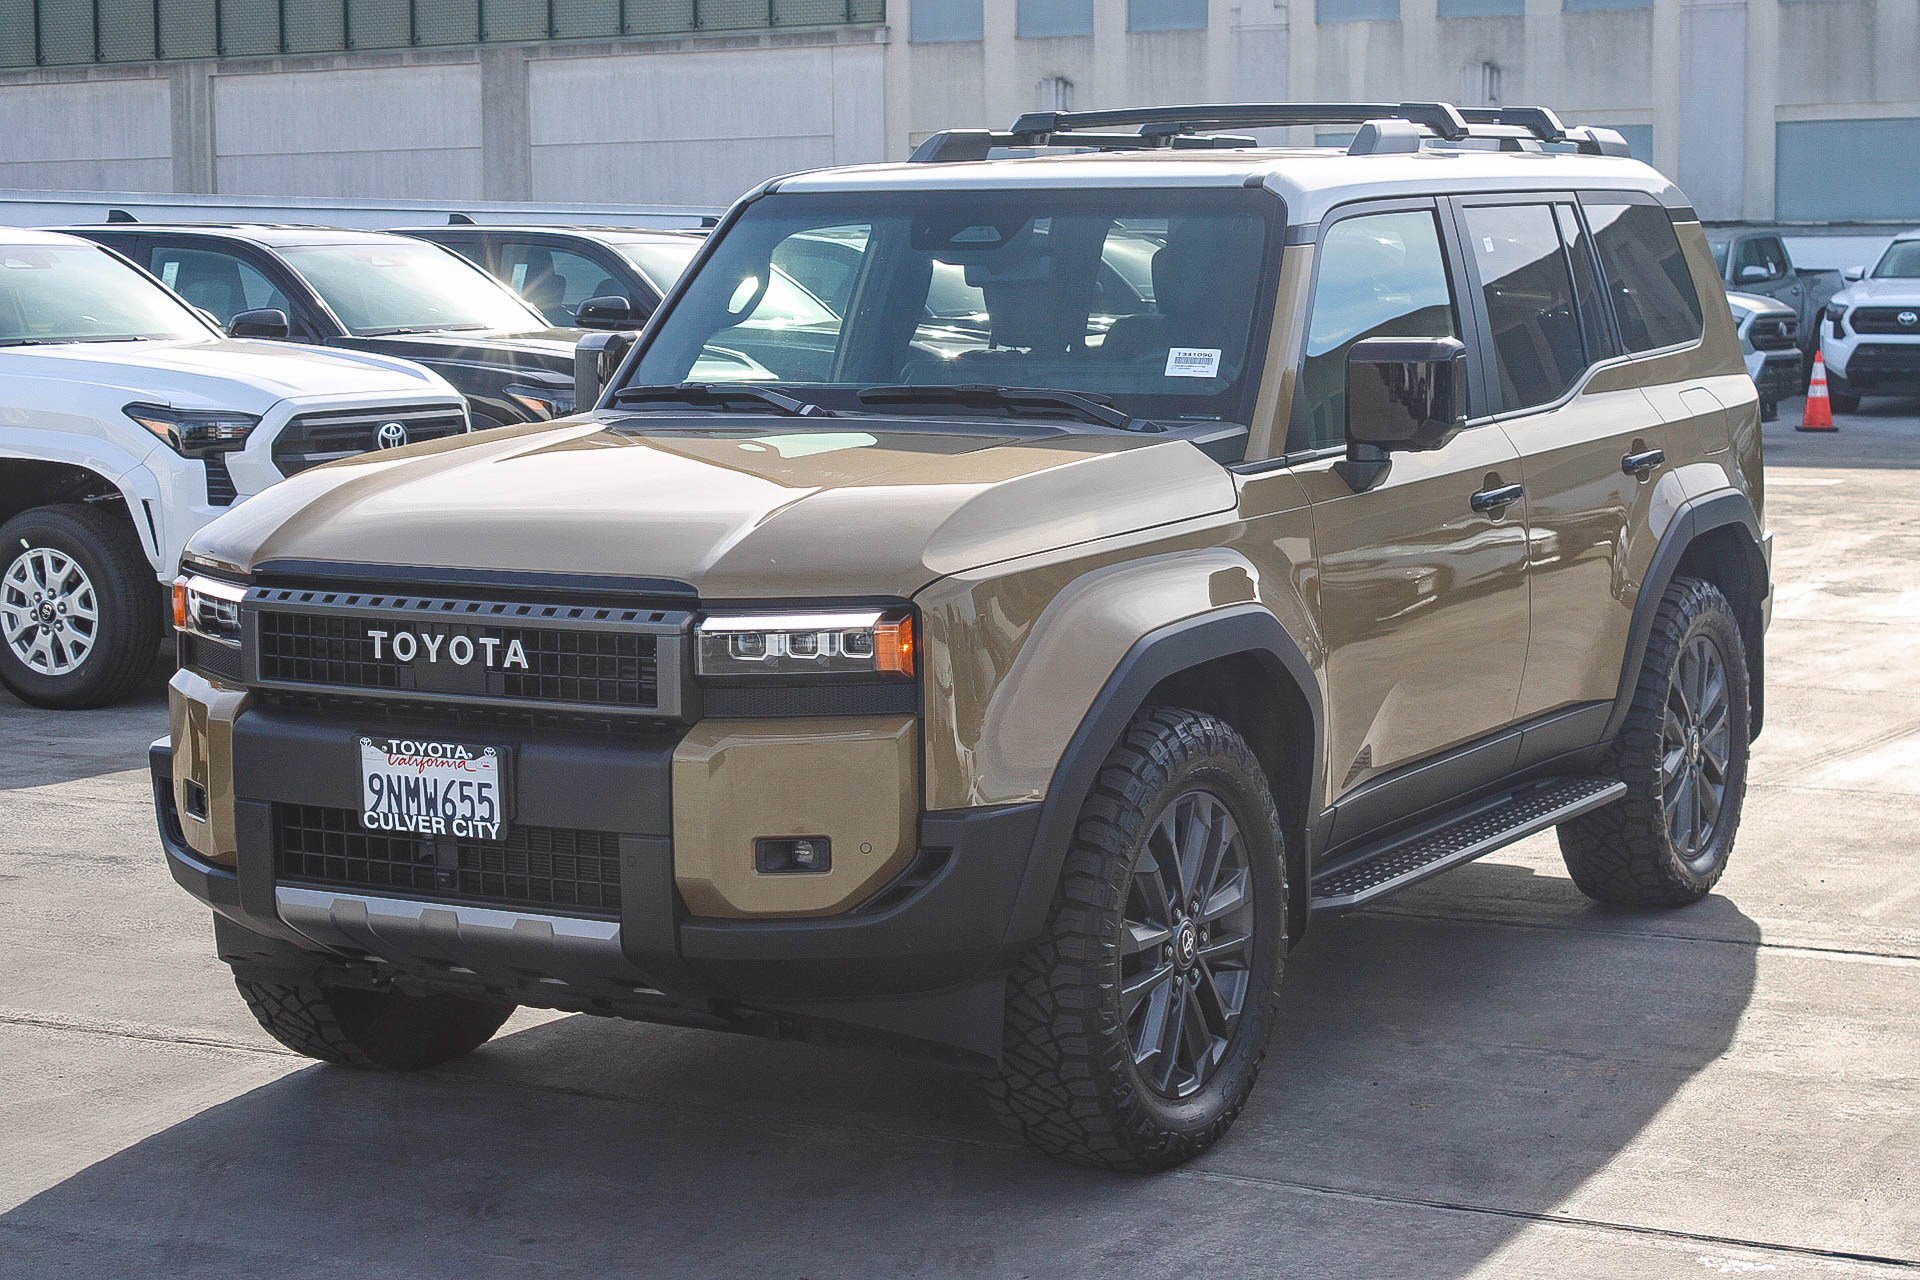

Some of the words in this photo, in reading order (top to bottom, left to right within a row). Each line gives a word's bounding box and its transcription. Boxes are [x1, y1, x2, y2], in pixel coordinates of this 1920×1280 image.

[367, 630, 529, 669] TOYOTA
[388, 739, 469, 759] TOYOTA
[387, 754, 477, 774] California
[368, 772, 495, 823] 9NMW655
[363, 811, 447, 835] CULVER
[452, 819, 500, 840] CITY
